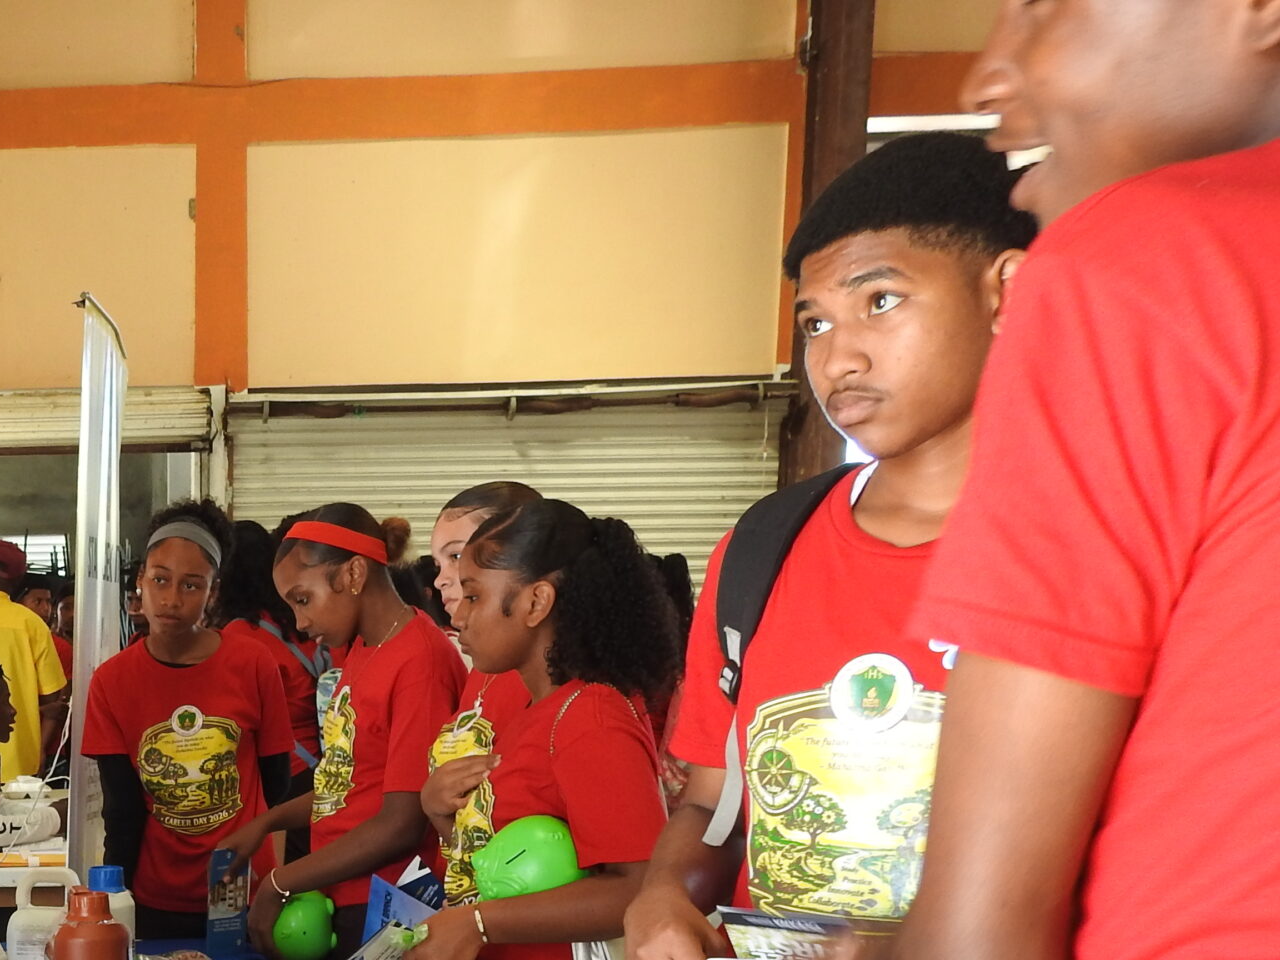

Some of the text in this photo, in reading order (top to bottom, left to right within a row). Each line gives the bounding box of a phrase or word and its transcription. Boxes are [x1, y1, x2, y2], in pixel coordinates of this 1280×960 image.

[164, 810, 229, 826] CAREER DAY 2026
